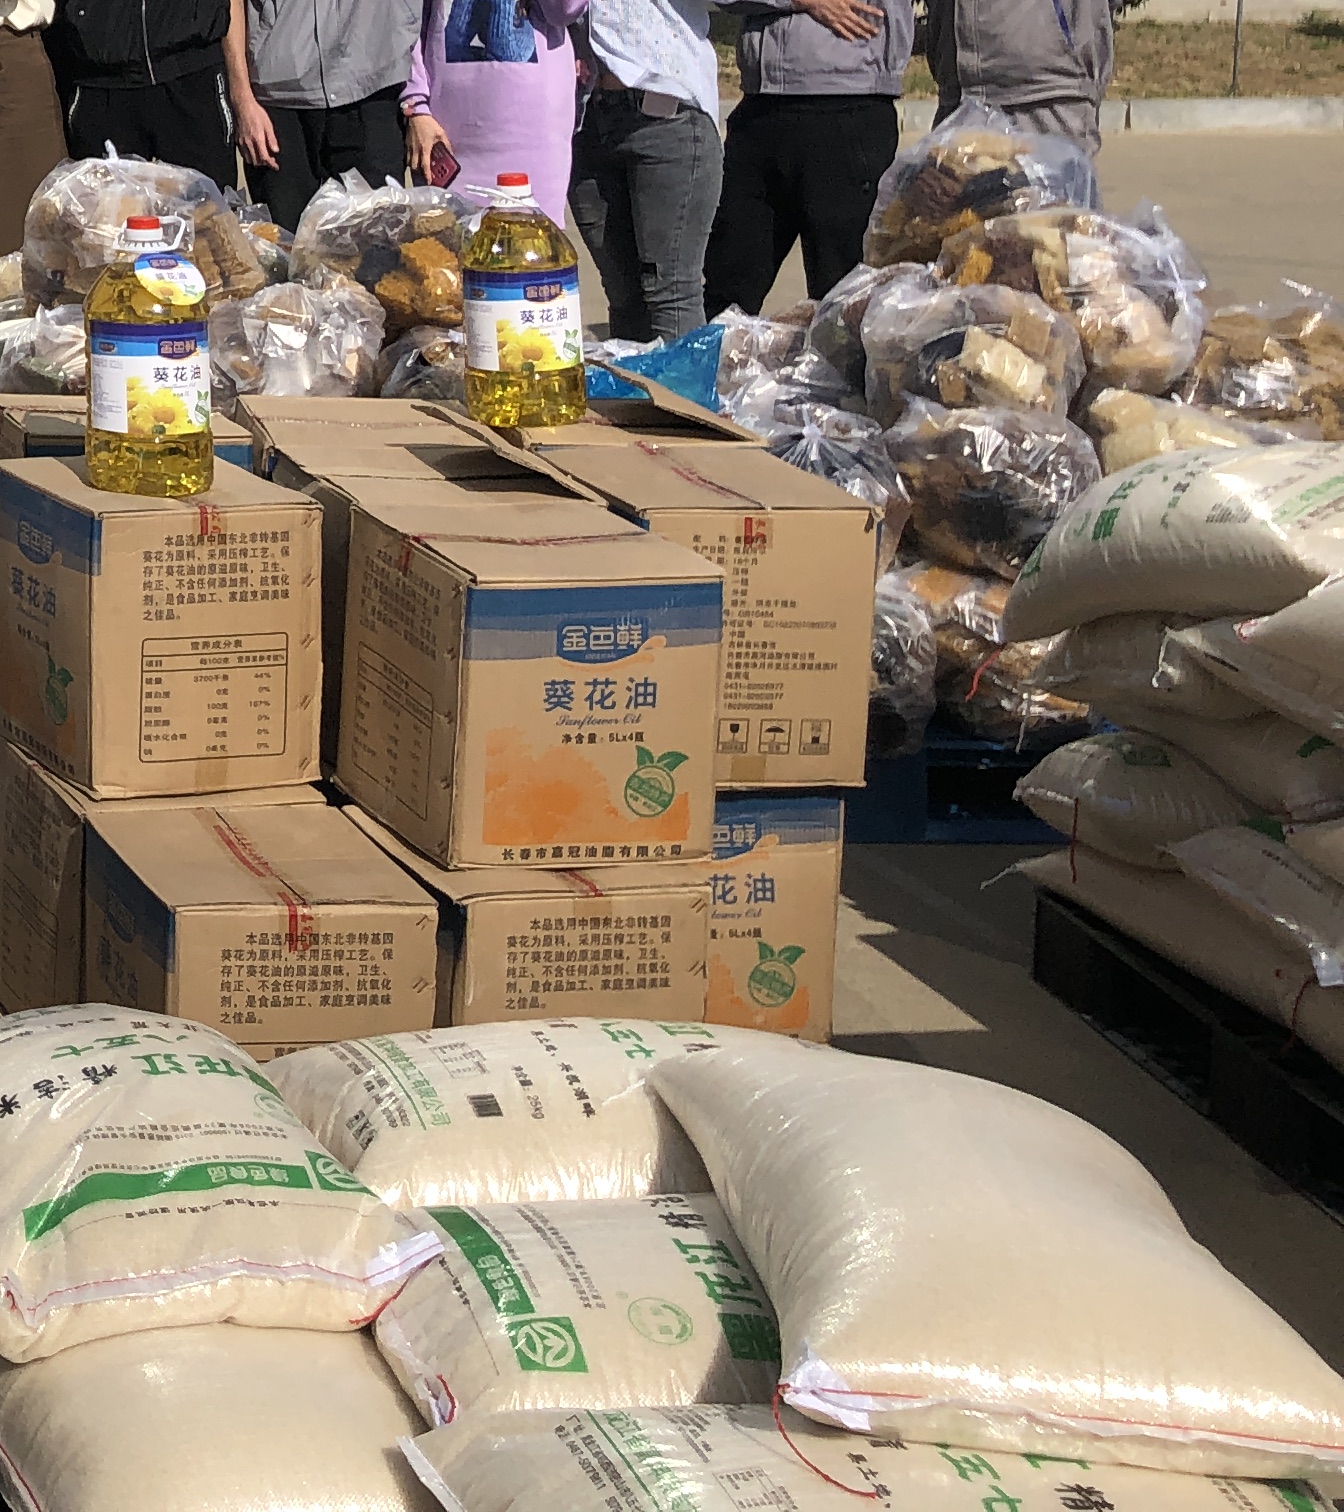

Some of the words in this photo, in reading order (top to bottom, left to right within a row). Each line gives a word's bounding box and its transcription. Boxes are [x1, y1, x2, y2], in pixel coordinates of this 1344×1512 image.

[519, 306, 569, 325] 葵花油
[152, 364, 202, 384] 葵花油
[542, 675, 659, 713] 葵花油
[52, 1033, 189, 1059] 八五七
